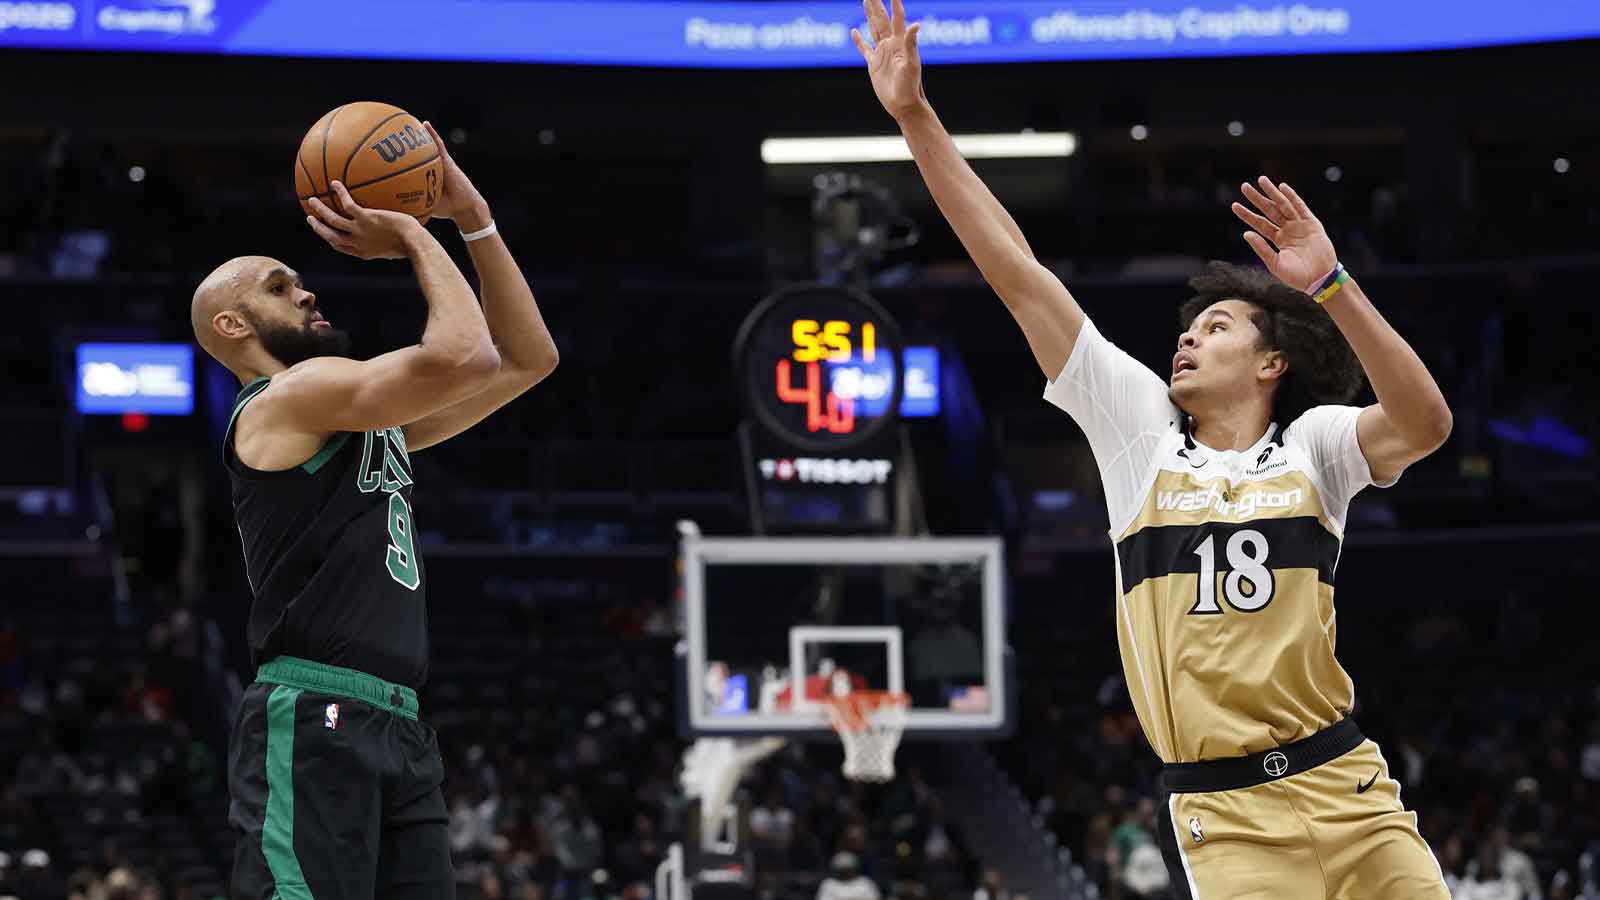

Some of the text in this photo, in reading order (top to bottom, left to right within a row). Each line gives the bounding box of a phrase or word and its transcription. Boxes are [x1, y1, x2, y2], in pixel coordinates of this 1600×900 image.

[759, 17, 846, 49] online
[1031, 12, 1137, 42] offered
[1139, 11, 1175, 45] by
[1177, 7, 1284, 43] Capital
[1287, 5, 1348, 35] One
[385, 491, 420, 591] 9
[1187, 529, 1275, 615] 18
